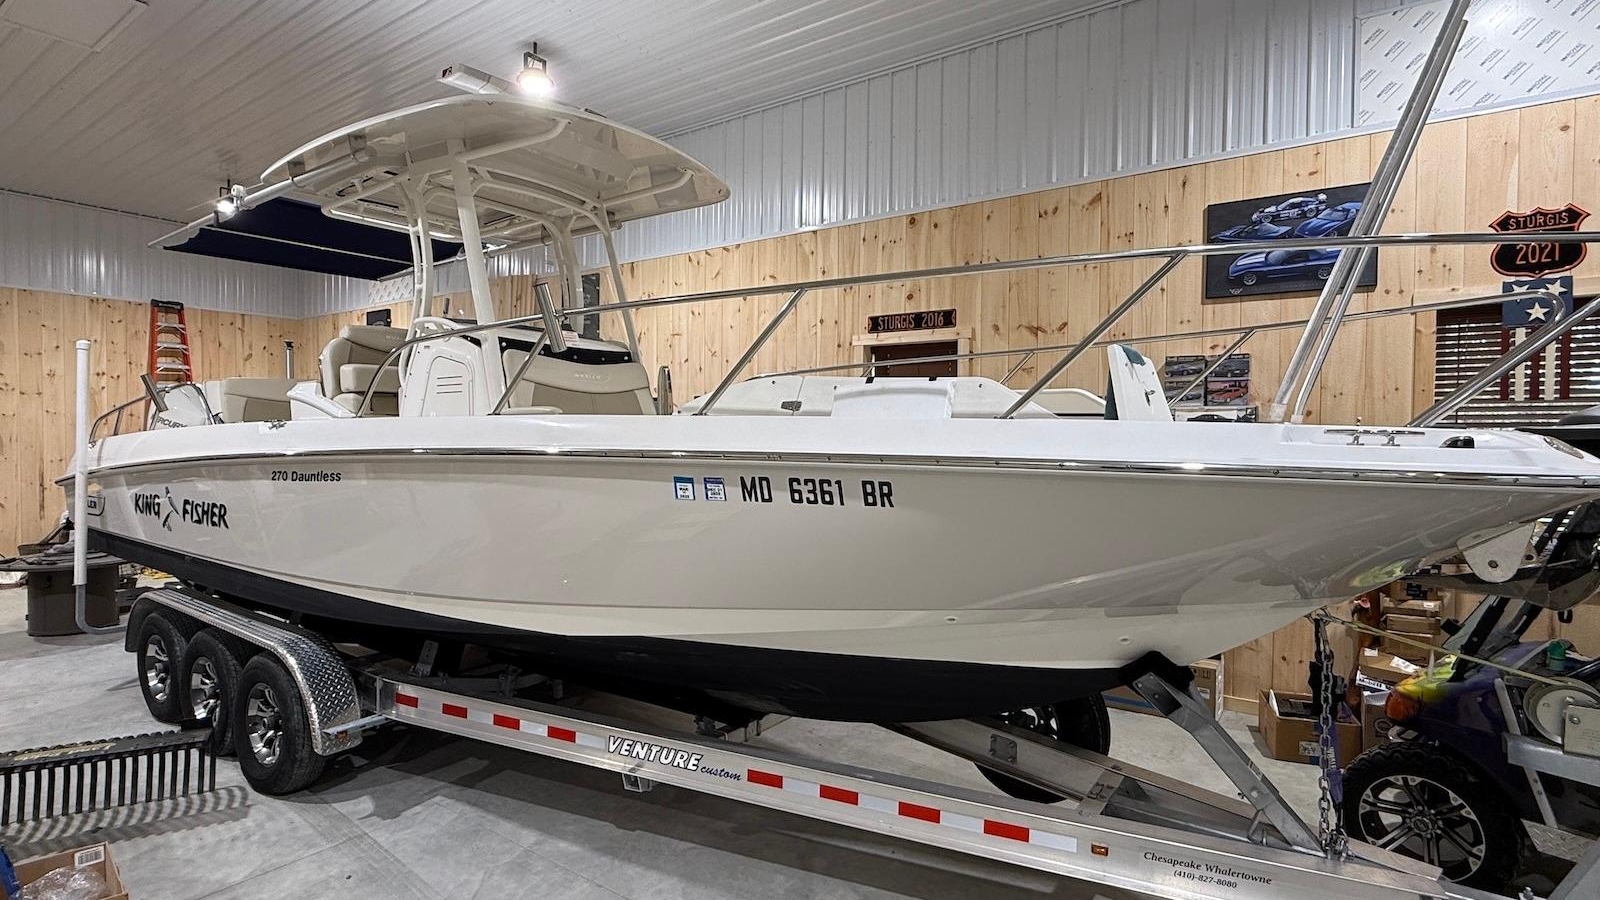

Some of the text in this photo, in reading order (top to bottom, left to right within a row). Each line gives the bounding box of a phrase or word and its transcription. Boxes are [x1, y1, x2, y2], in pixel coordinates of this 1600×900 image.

[1508, 212, 1569, 230] STURGIS
[1516, 242, 1560, 264] 2021
[878, 312, 944, 330] STURGIS 2016
[271, 470, 342, 482] 270 Dauntless
[740, 476, 894, 508] MD 6361 BR
[134, 492, 229, 529] KING FISHER
[608, 736, 742, 781] VENTURE custom
[1143, 851, 1272, 885] Chesapeake Whalertowne
[1173, 869, 1238, 888] (410)-827-8080
